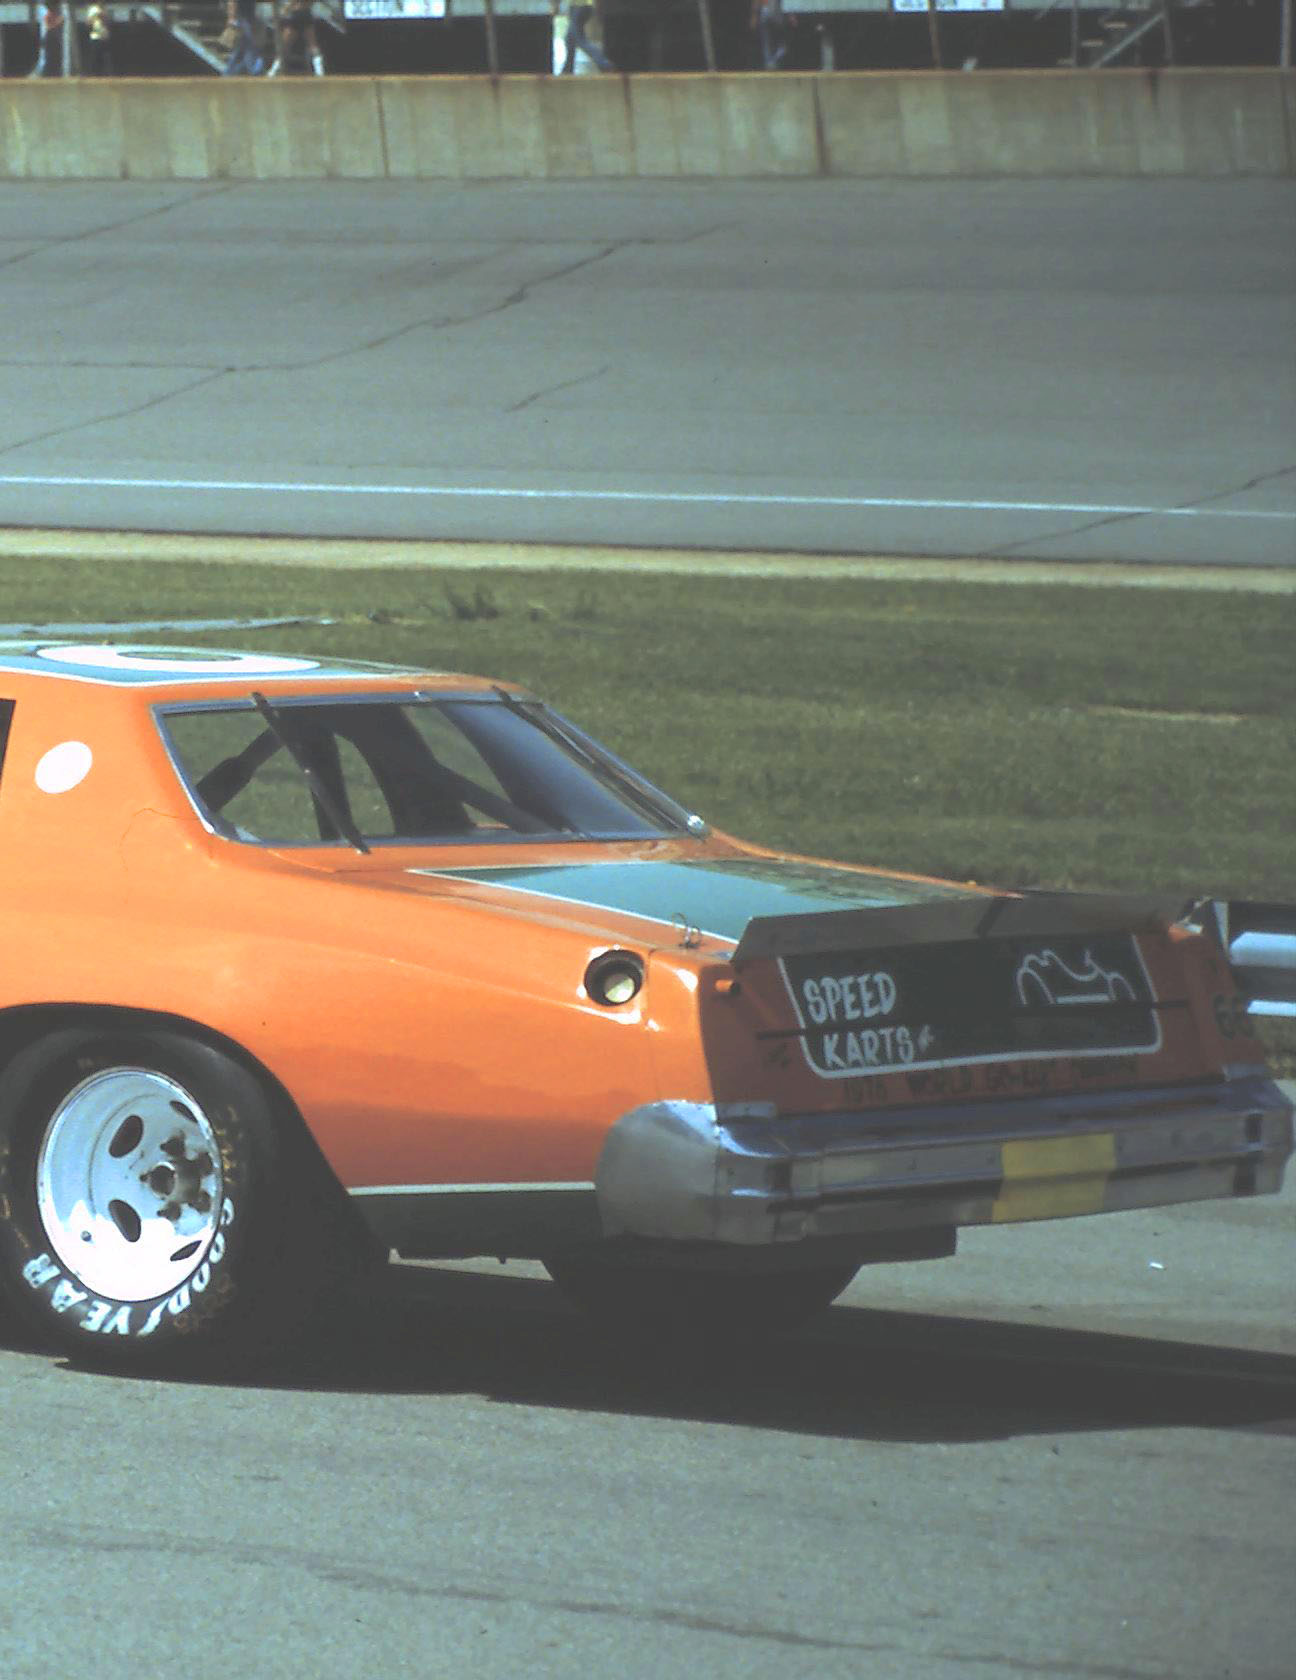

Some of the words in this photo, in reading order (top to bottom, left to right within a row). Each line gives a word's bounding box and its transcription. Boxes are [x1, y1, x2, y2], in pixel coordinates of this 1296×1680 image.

[803, 970, 897, 1024] SPEED
[823, 1025, 915, 1069] KARTS
[22, 1197, 234, 1336] GOODYEAR
